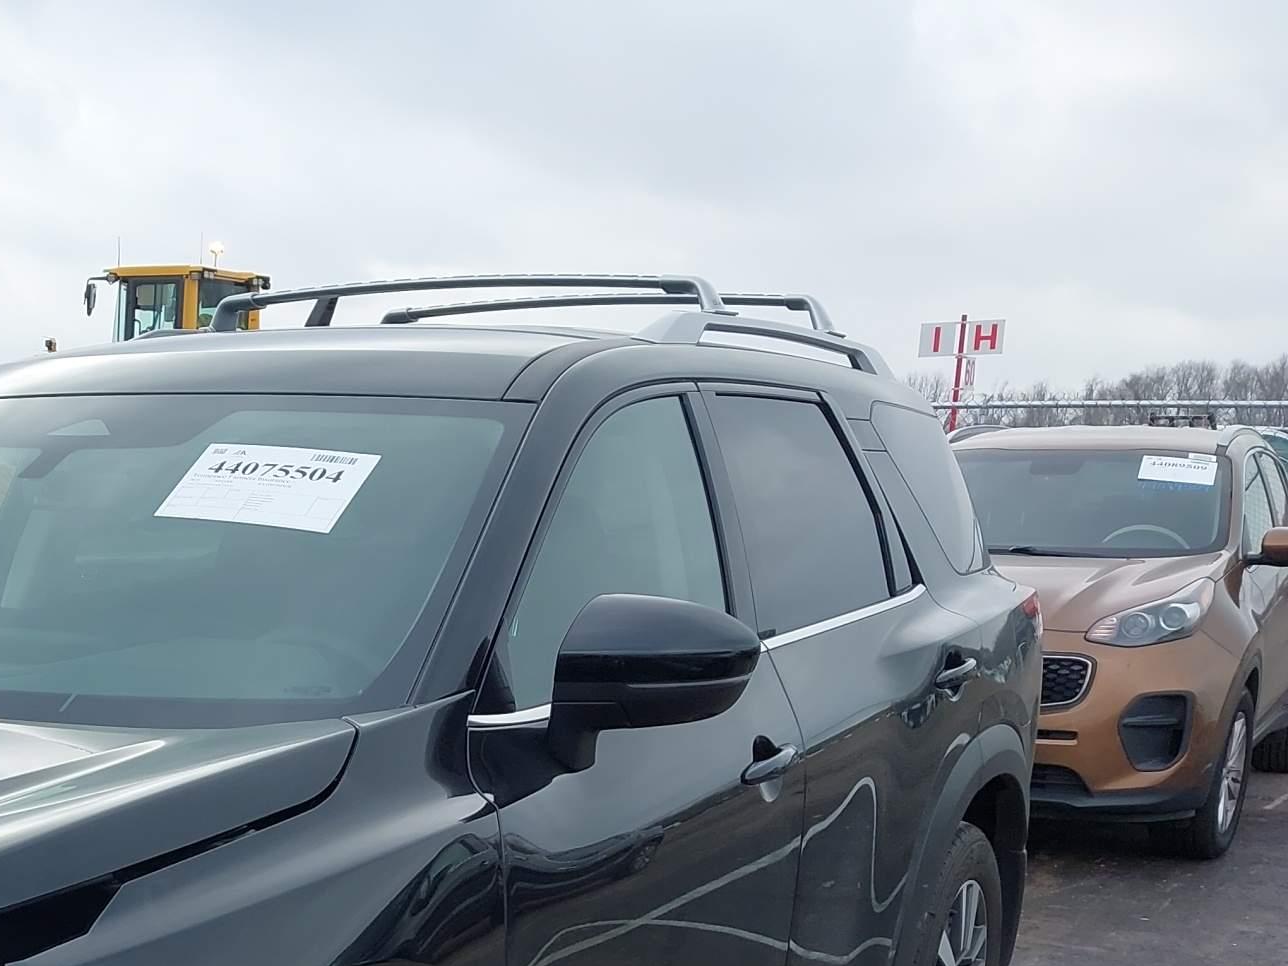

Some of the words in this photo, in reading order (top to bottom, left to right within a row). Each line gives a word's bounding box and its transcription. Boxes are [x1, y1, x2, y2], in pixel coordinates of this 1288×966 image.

[933, 326, 941, 352] I
[974, 324, 997, 350] H
[208, 460, 344, 483] 44075504
